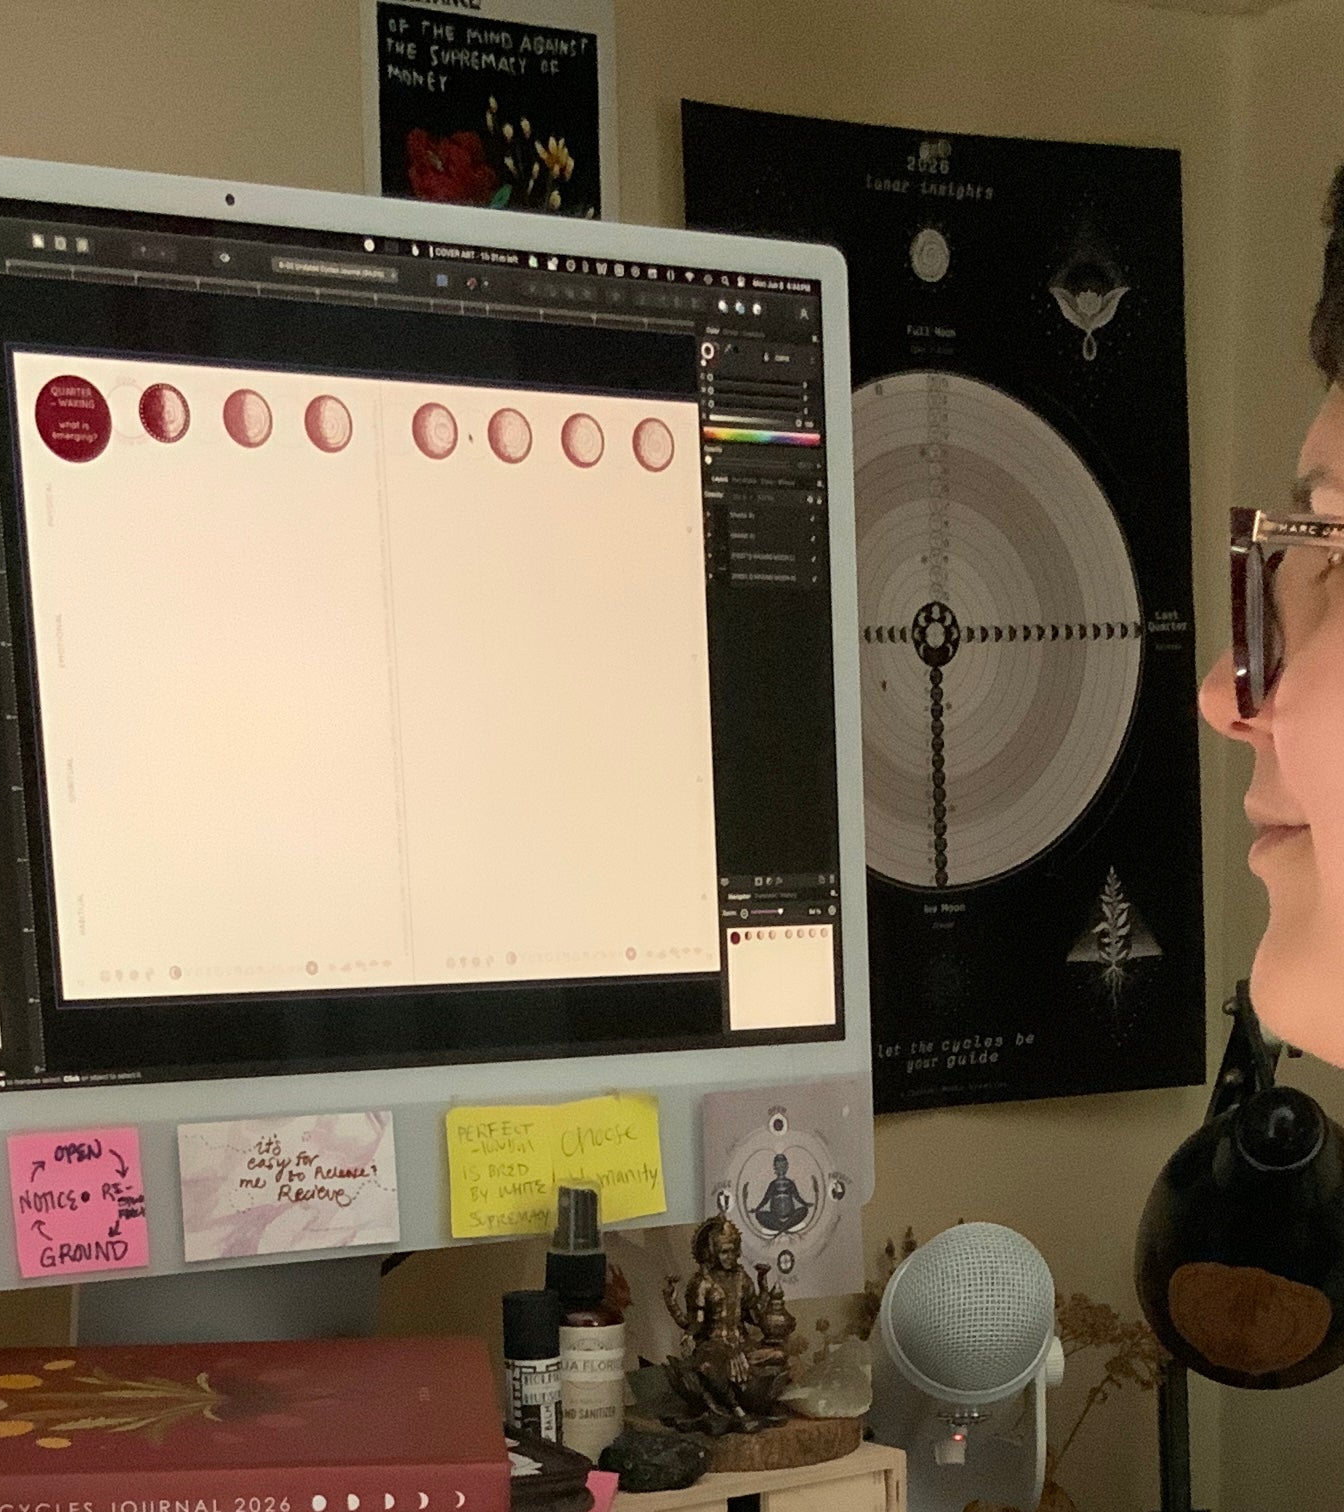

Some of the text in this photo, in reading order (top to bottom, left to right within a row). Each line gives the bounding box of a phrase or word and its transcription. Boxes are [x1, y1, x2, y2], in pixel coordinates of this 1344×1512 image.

[421, 20, 455, 41] THE
[467, 28, 513, 49] MIND
[520, 34, 589, 58] AGAINST
[386, 37, 417, 59] THE
[430, 45, 526, 75] SUPREMACY
[387, 64, 447, 92] MONEY
[906, 156, 951, 175] 2026
[50, 386, 93, 398] QUARTER
[941, 1035, 1003, 1053] cycles
[1015, 1032, 1035, 1046] be
[946, 1050, 999, 1069] guide
[457, 1120, 535, 1142] PERFECT
[54, 1138, 103, 1164] OPEN
[246, 1151, 319, 1183] easy for
[462, 1162, 530, 1182] IS BRED
[239, 1176, 267, 1190] me
[288, 1171, 306, 1183] to
[498, 1181, 547, 1200] WHITE
[19, 1189, 79, 1214] NOTICE
[39, 1239, 129, 1268] GROUND
